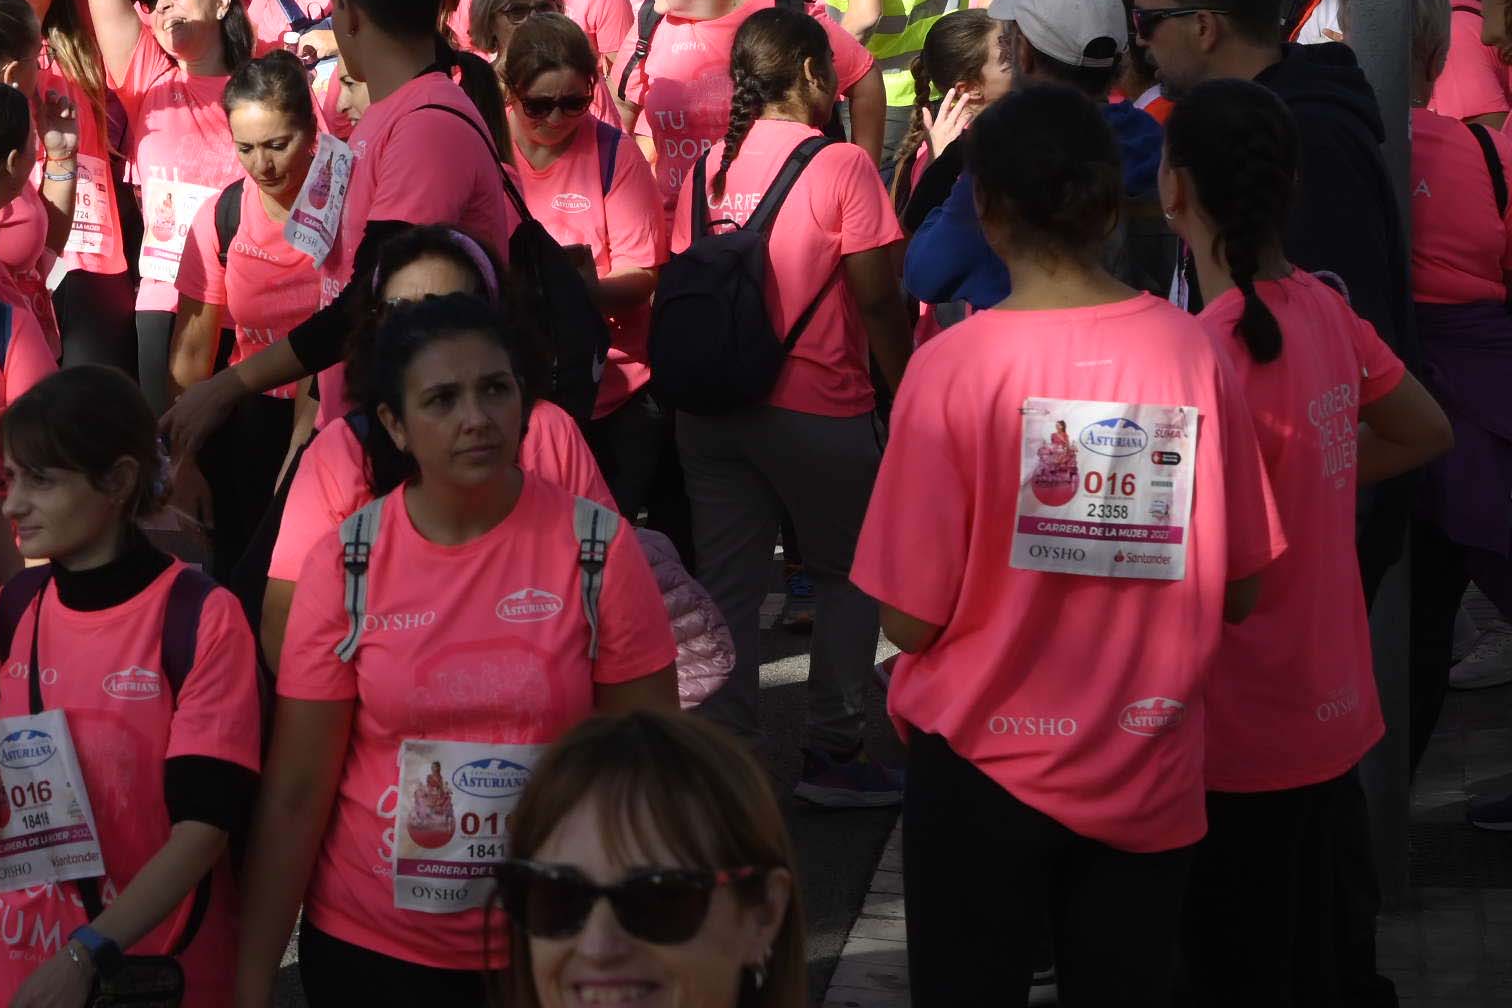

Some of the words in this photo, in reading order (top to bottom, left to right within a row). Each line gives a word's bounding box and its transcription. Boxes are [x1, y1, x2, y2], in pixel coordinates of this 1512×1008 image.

[654, 111, 685, 130] TU
[1084, 470, 1137, 496] 016
[1087, 503, 1129, 519] 23358
[1037, 522, 1087, 536] CARRERA
[1089, 526, 1103, 536] DE
[1105, 527, 1117, 537] LA
[1118, 528, 1148, 538] MUJER
[1028, 544, 1086, 562] OYSHO
[1125, 552, 1172, 565] Santander
[362, 611, 437, 633] OYSHO
[988, 715, 1077, 737] OYSHO
[11, 780, 54, 808] 016
[416, 863, 469, 876] CARRERA
[411, 885, 469, 902] OYSHO
